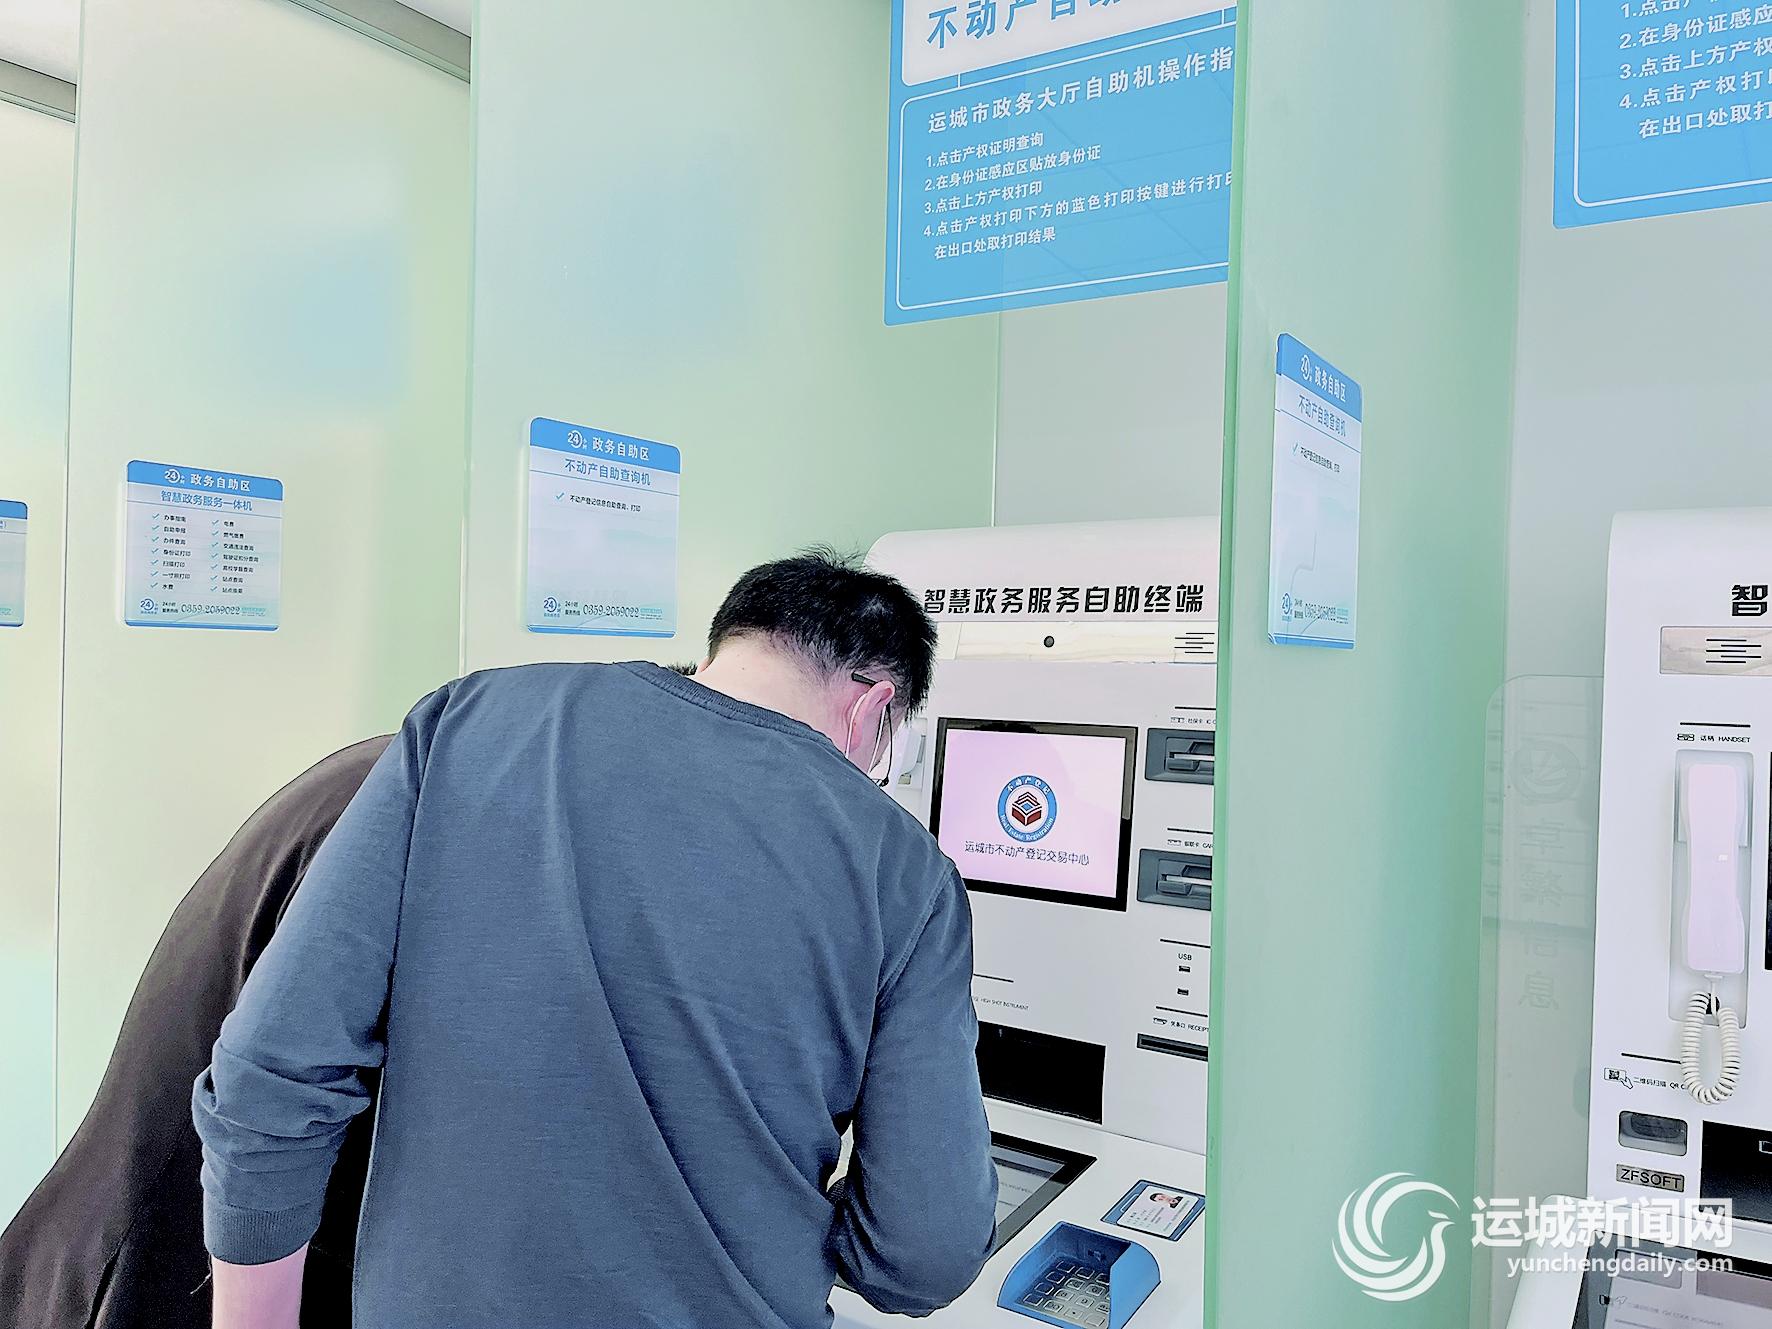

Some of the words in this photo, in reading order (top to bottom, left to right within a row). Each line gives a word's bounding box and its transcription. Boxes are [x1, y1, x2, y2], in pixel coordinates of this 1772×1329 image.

[928, 46, 1234, 134] 运城市政务大厅自助机操作指
[1618, 68, 1772, 110] 4.点击产权打
[926, 131, 1045, 169] 1.点击产权证明查询
[924, 144, 1102, 192] 2.在身份证感应区贴放身份证
[923, 180, 1043, 215] 3.点击上方产权打印
[934, 226, 1057, 260] 在出口处取打印结果
[1315, 366, 1347, 403] 政务自助区
[592, 437, 650, 461] 政务自助区
[190, 473, 251, 492] 政务自助区
[564, 458, 651, 486] 不动产自助查询机
[161, 490, 253, 511] 智慧政务服务一体机
[924, 584, 1205, 614] 智慧政务服务自助终端
[1731, 584, 1769, 617] 智
[1718, 736, 1751, 744] HANDSET
[964, 840, 1090, 867] 运城市不动产登记交易中心
[1178, 953, 1192, 961] USB
[1620, 1169, 1682, 1190] ZFSOFT
